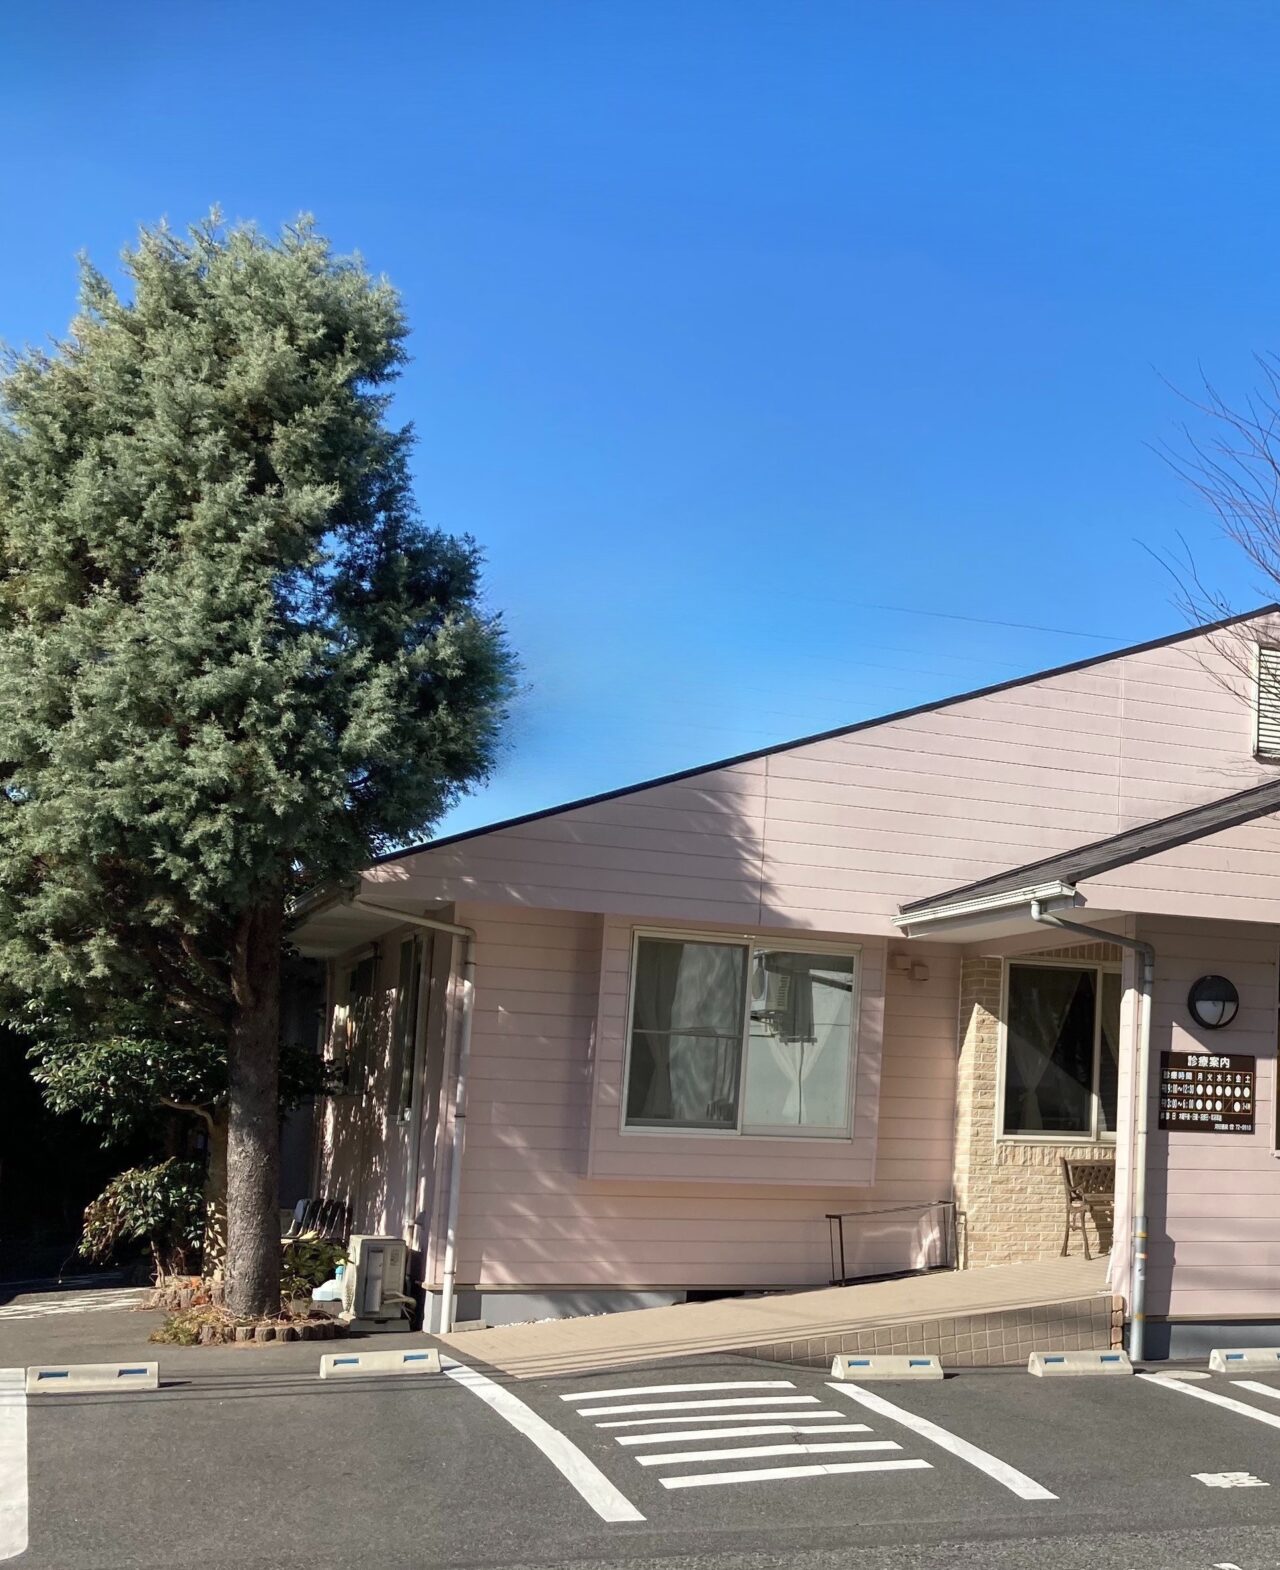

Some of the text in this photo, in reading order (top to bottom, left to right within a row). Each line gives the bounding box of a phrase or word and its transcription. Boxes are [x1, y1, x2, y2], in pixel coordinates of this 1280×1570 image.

[1187, 1055, 1231, 1069] 診療案内
[1197, 1072, 1203, 1081] 月
[1244, 1075, 1251, 1083] 土
